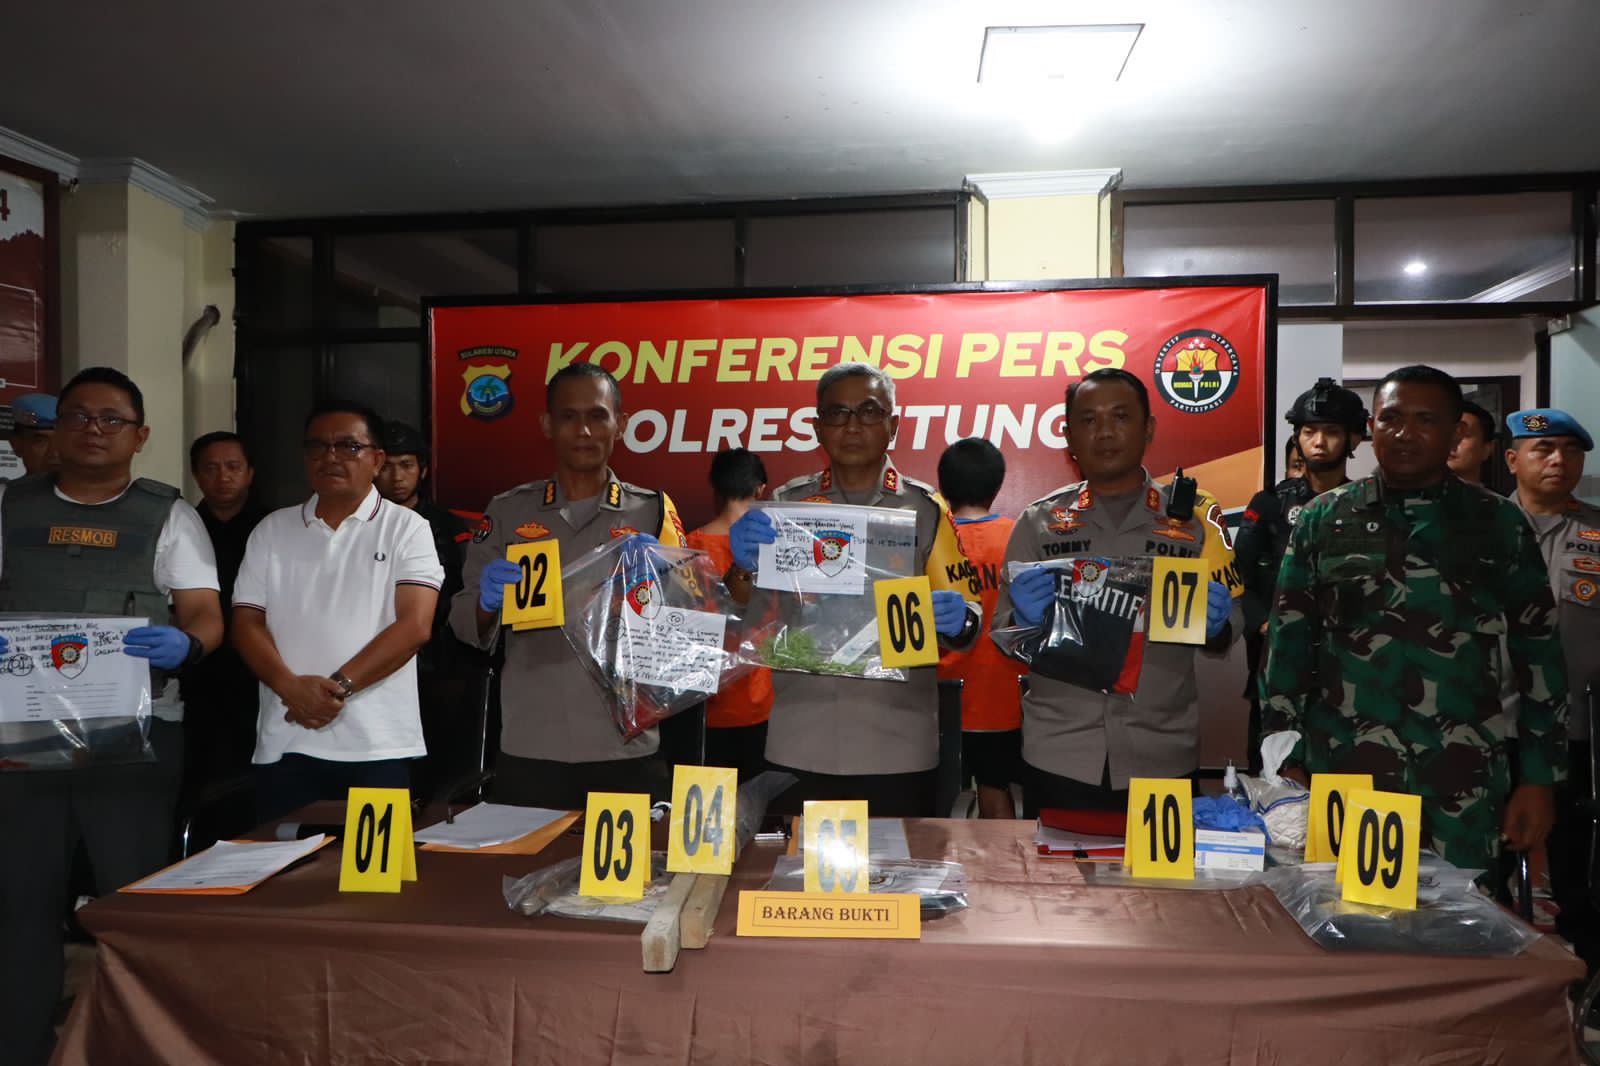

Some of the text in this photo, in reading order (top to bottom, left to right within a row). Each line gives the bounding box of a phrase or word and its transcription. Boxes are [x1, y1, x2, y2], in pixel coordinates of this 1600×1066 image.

[544, 329, 1129, 385] KONFERENSI PERS
[623, 406, 821, 454] OLRES
[52, 528, 113, 545] RESMOB
[1042, 540, 1092, 557] TOMMY
[515, 552, 548, 610] 02
[1162, 570, 1199, 629] 07
[887, 591, 925, 653] 06
[355, 802, 393, 873] 01
[593, 808, 634, 881] 03
[682, 783, 724, 857] 04
[1142, 793, 1182, 864] 10
[1357, 808, 1405, 889] 09
[817, 818, 857, 893] 05
[761, 905, 890, 922] BARANG BUKTI
